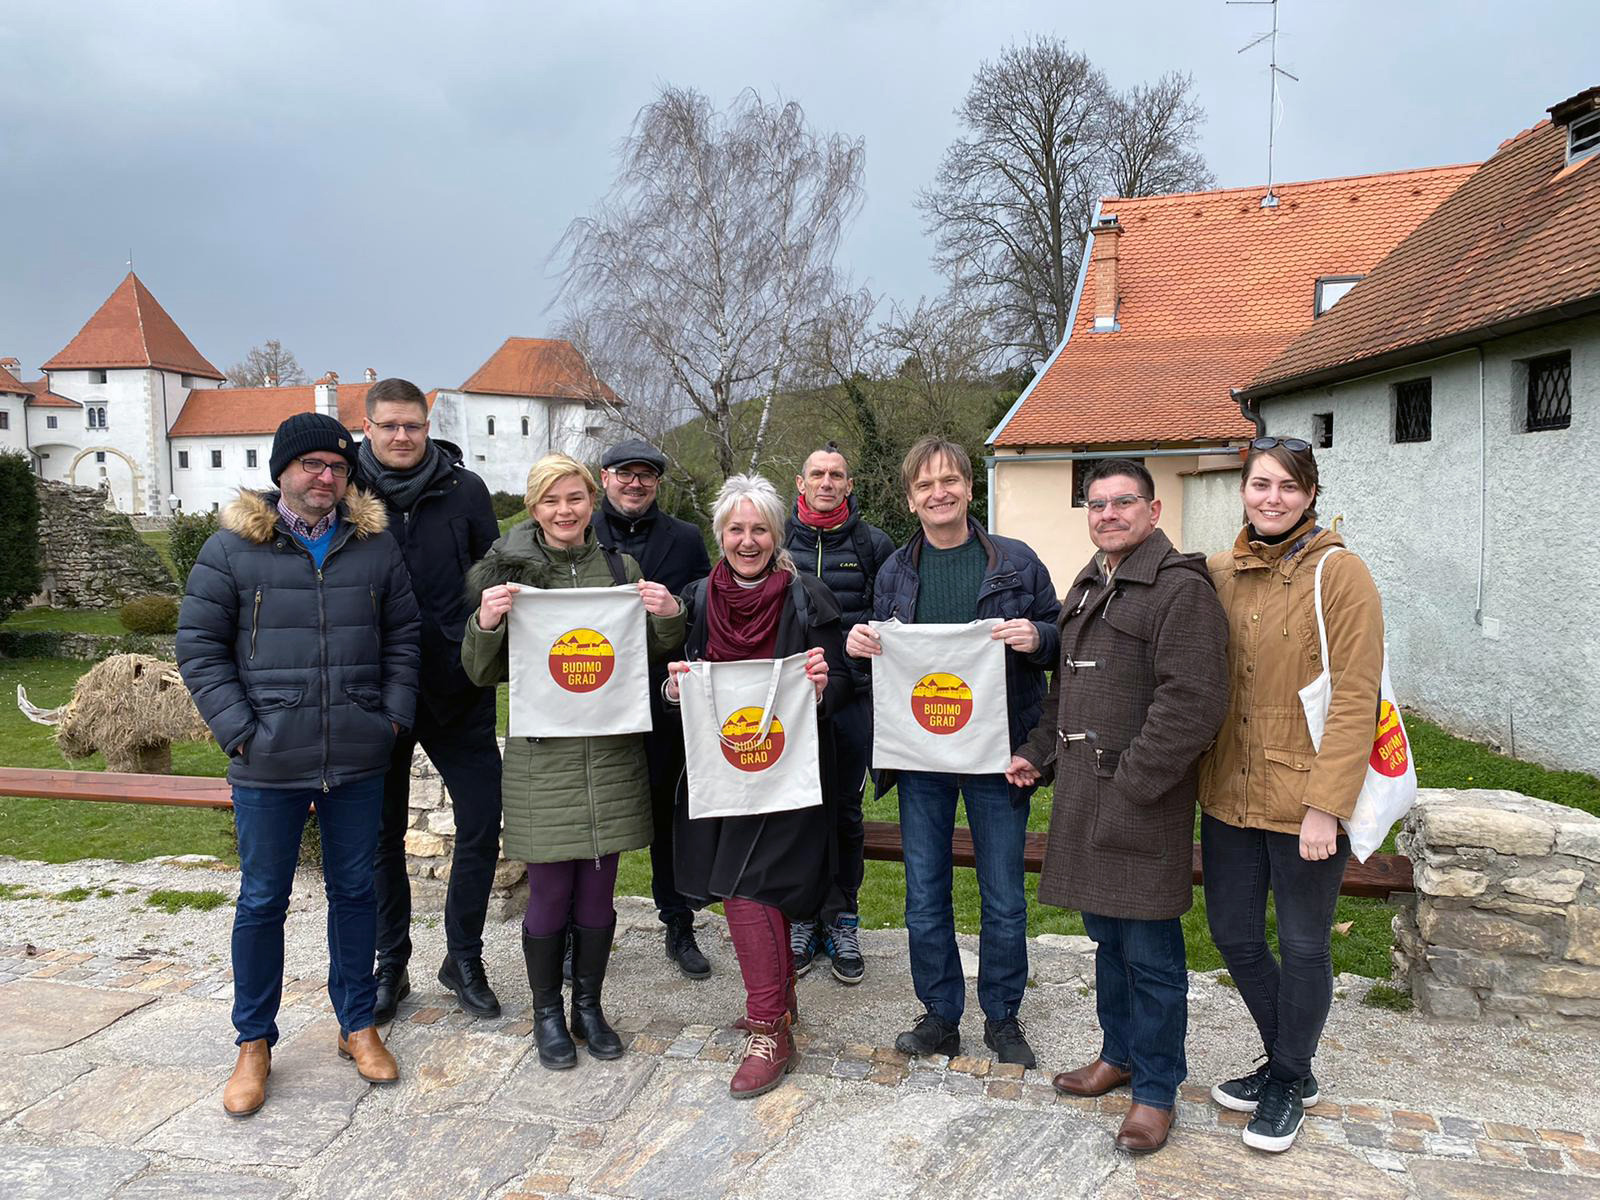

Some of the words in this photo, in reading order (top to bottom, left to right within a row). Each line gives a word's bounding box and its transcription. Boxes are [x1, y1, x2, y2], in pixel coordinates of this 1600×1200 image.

[562, 661, 602, 673] BUDIMO
[568, 673, 596, 685] GRAD
[924, 703, 961, 715] BUDIMO
[929, 715, 956, 727] GRAD
[740, 751, 768, 765] GRAD
